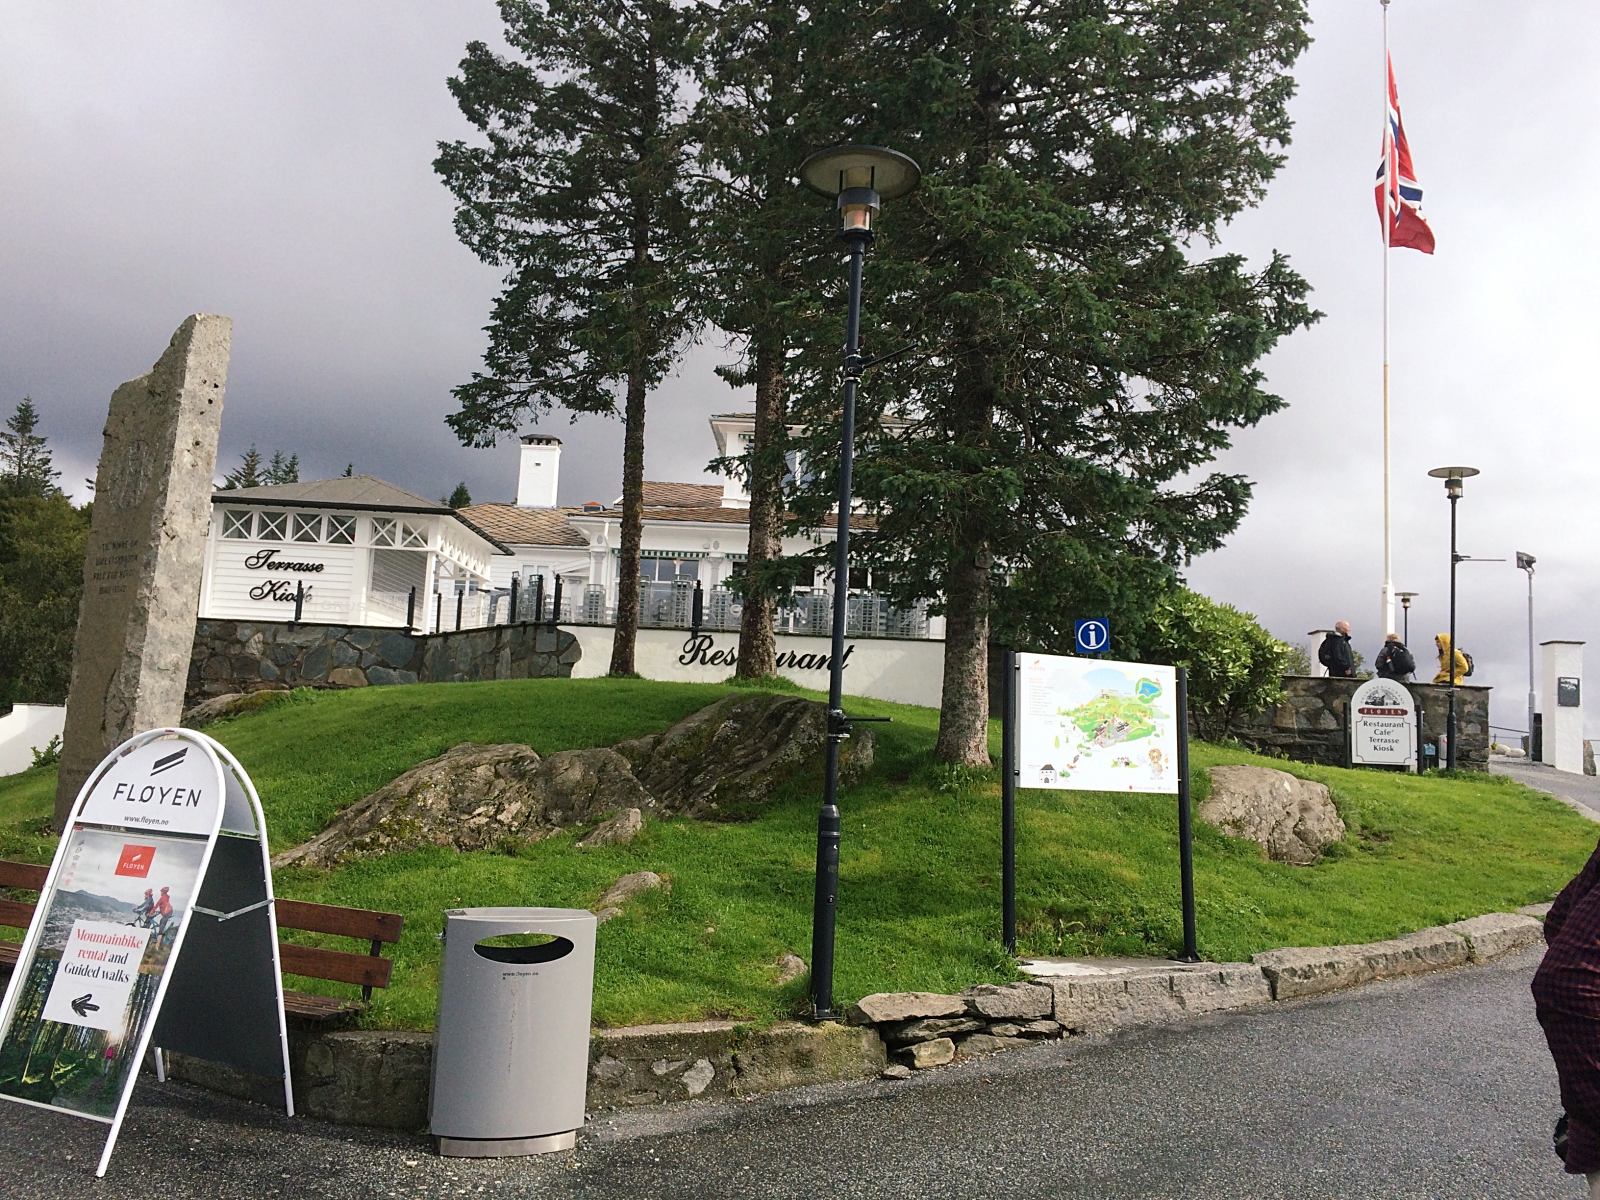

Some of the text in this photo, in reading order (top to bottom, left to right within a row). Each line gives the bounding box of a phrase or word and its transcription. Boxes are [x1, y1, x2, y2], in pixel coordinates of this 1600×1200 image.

[244, 549, 324, 573] Terrasse
[249, 579, 314, 603] Kiok
[678, 634, 856, 671] Resurant
[1363, 720, 1404, 728] Restaurant
[1369, 736, 1400, 744] Terrasse
[112, 782, 202, 807] FLØYEN
[76, 928, 143, 949] Mountainbike
[77, 949, 129, 965] rental and
[64, 961, 131, 984] Guided walks
